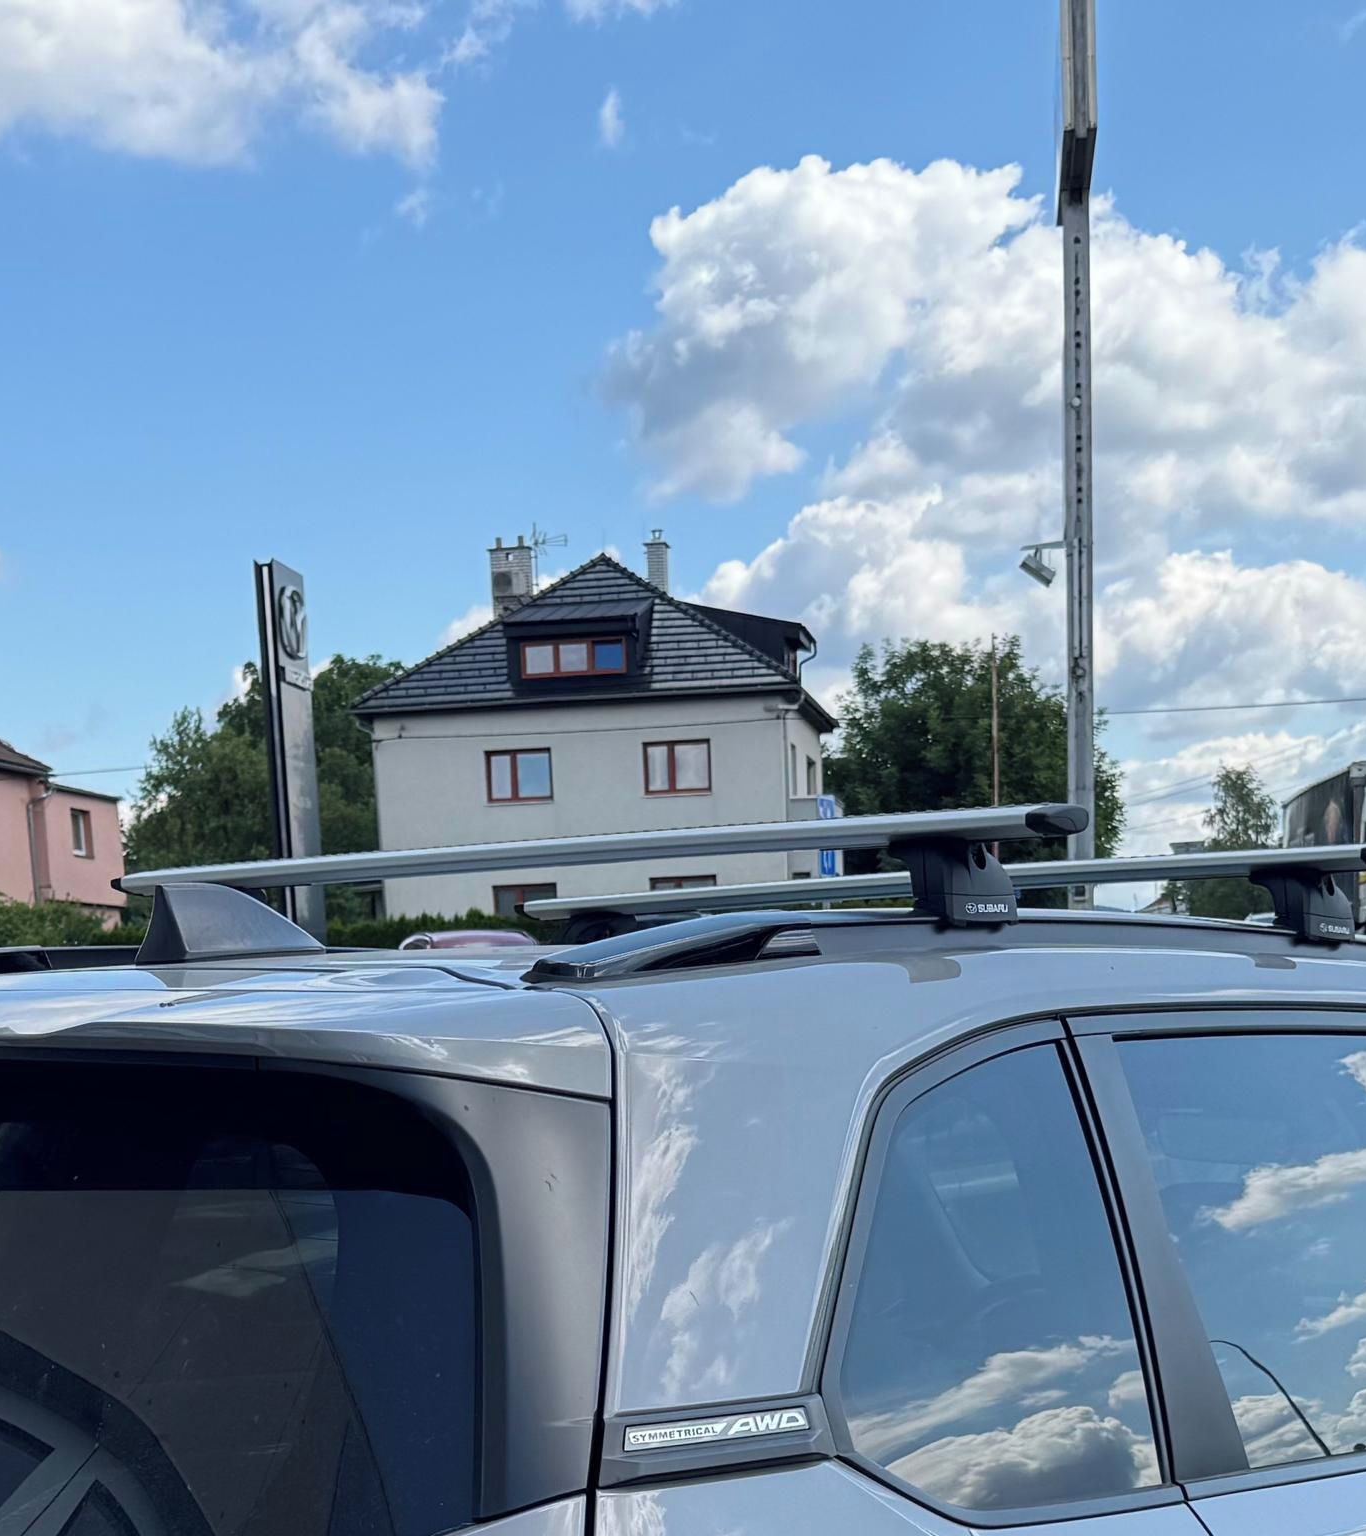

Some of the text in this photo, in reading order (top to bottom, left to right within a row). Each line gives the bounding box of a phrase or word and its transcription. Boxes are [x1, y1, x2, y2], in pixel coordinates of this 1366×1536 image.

[978, 904, 1008, 912] SUBARU
[632, 1411, 806, 1444] SYMMETRICAL AWD
